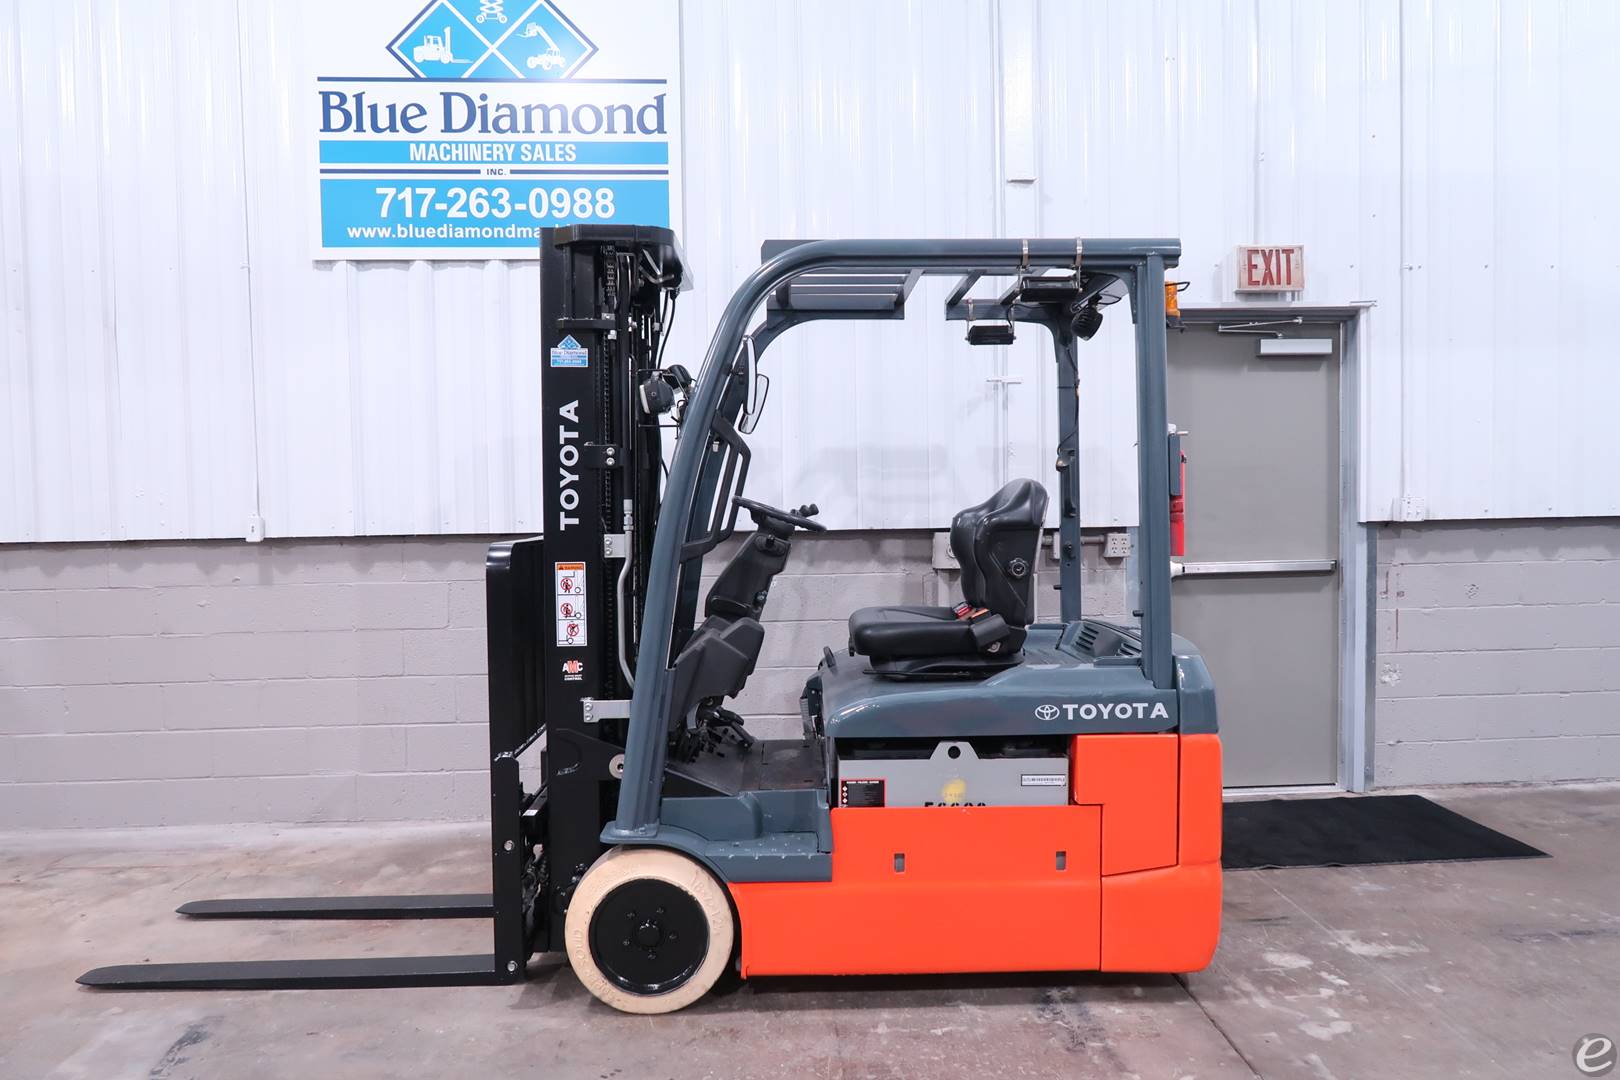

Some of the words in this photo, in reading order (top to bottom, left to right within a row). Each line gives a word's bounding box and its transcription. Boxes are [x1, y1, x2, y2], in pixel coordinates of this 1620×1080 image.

[319, 91, 428, 134] Blue
[440, 92, 668, 135] Diamond
[409, 143, 515, 162] MACHINERY
[520, 143, 577, 162] SALES
[486, 167, 507, 176] INC.
[375, 187, 616, 220] 717-263-0988
[346, 223, 570, 241] www.bluediamondma
[1246, 248, 1295, 286] EXIT
[559, 399, 580, 531] TOYOTA
[1062, 702, 1169, 720] TOYOTA
